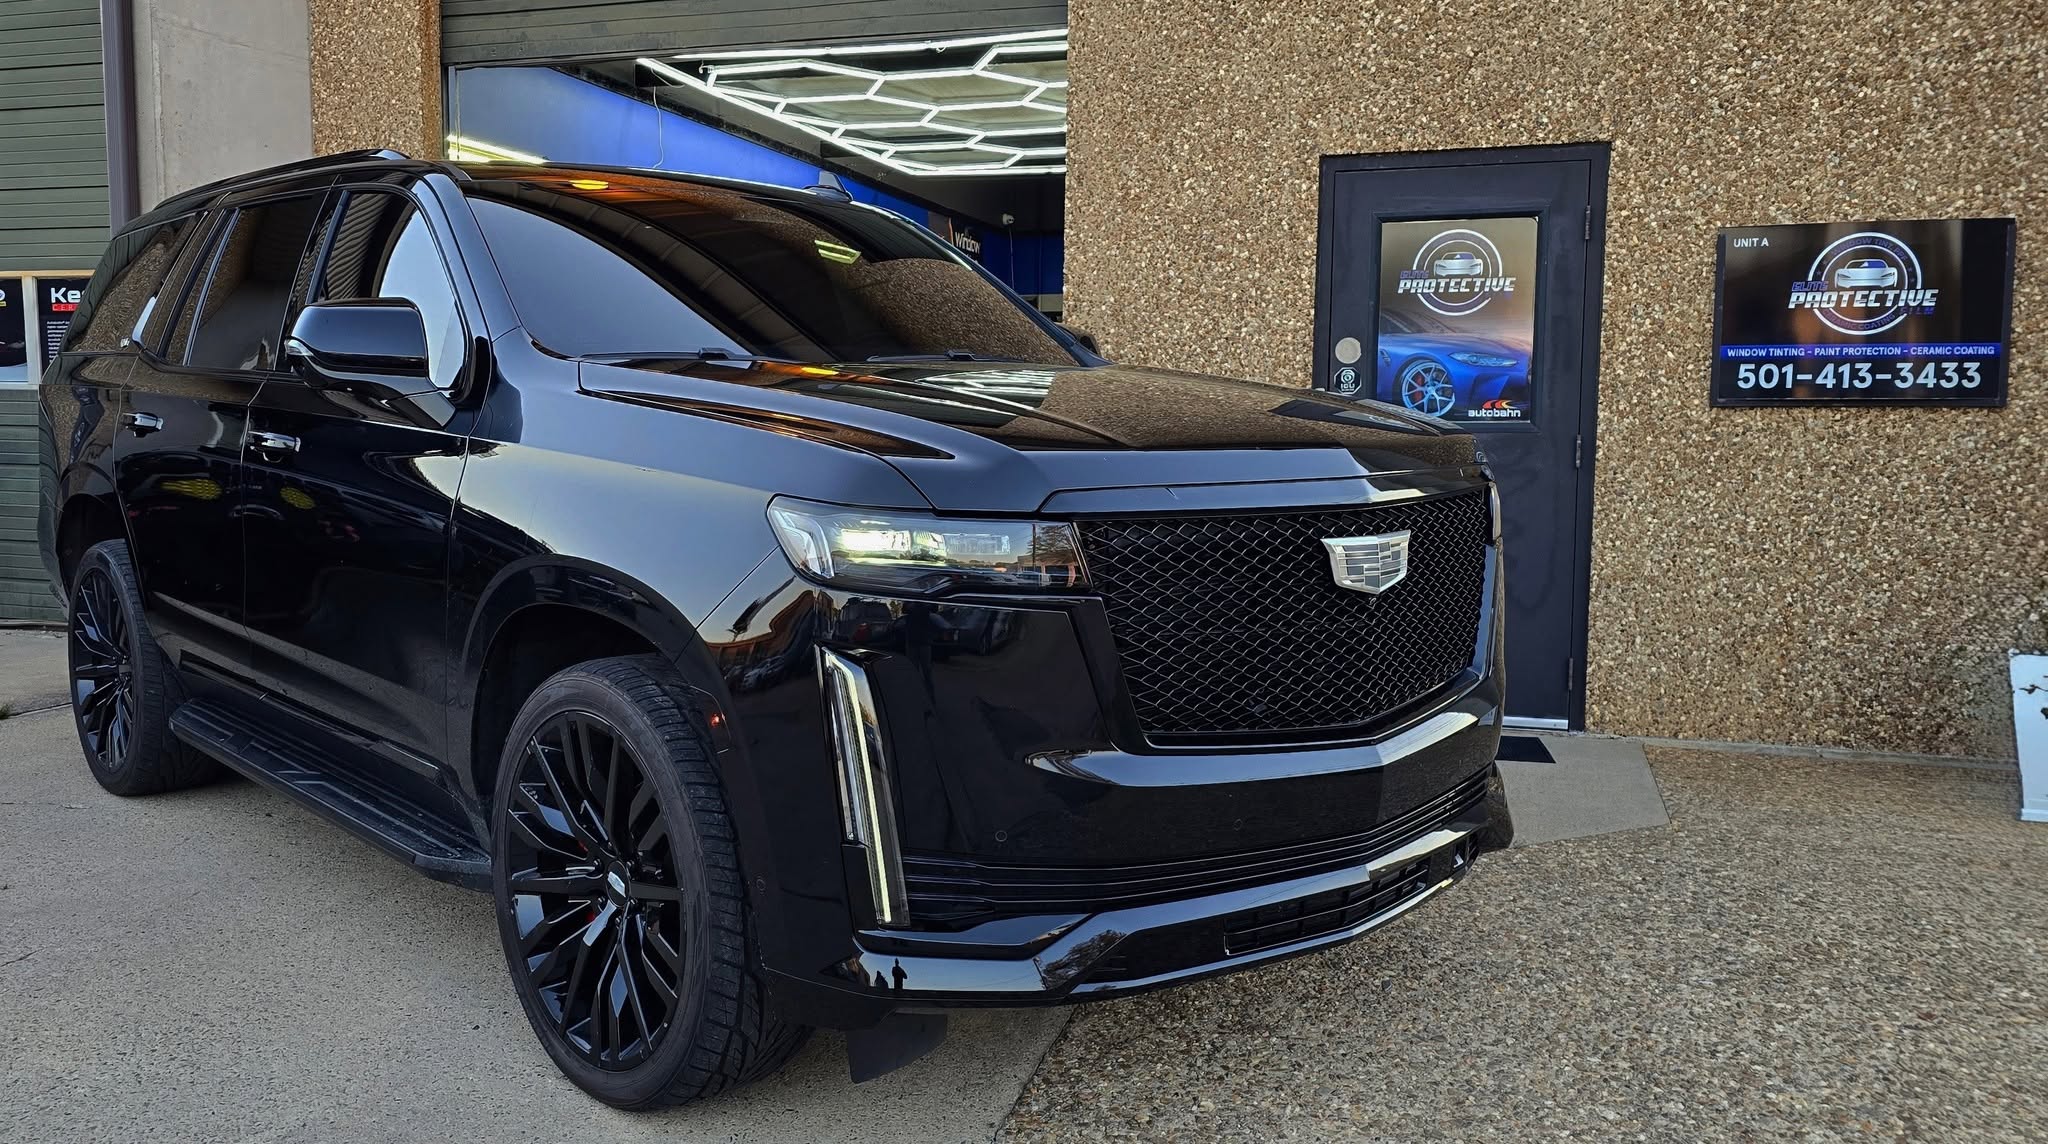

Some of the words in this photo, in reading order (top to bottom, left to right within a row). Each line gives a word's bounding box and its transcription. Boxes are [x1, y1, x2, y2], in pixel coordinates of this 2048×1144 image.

[1733, 237, 1759, 248] UNIT
[1761, 238, 1770, 247] A
[1831, 237, 1872, 255] WINDOW
[1398, 277, 1516, 293] PROTECTIVE
[50, 287, 86, 304] Ke
[1789, 289, 1938, 309] PROTECTIVE
[52, 304, 78, 312] CER
[1859, 313, 1896, 330] COATING
[1727, 347, 1767, 358] WINDOW
[1768, 347, 1805, 357] TINTING
[1814, 347, 1841, 356] PAINT
[1843, 346, 1901, 356] PROTECTION
[1910, 346, 1952, 356] CERAMIC
[1954, 345, 1995, 356] COATING
[1736, 361, 1982, 390] 501-413-3433
[1468, 408, 1521, 418] autobahn
